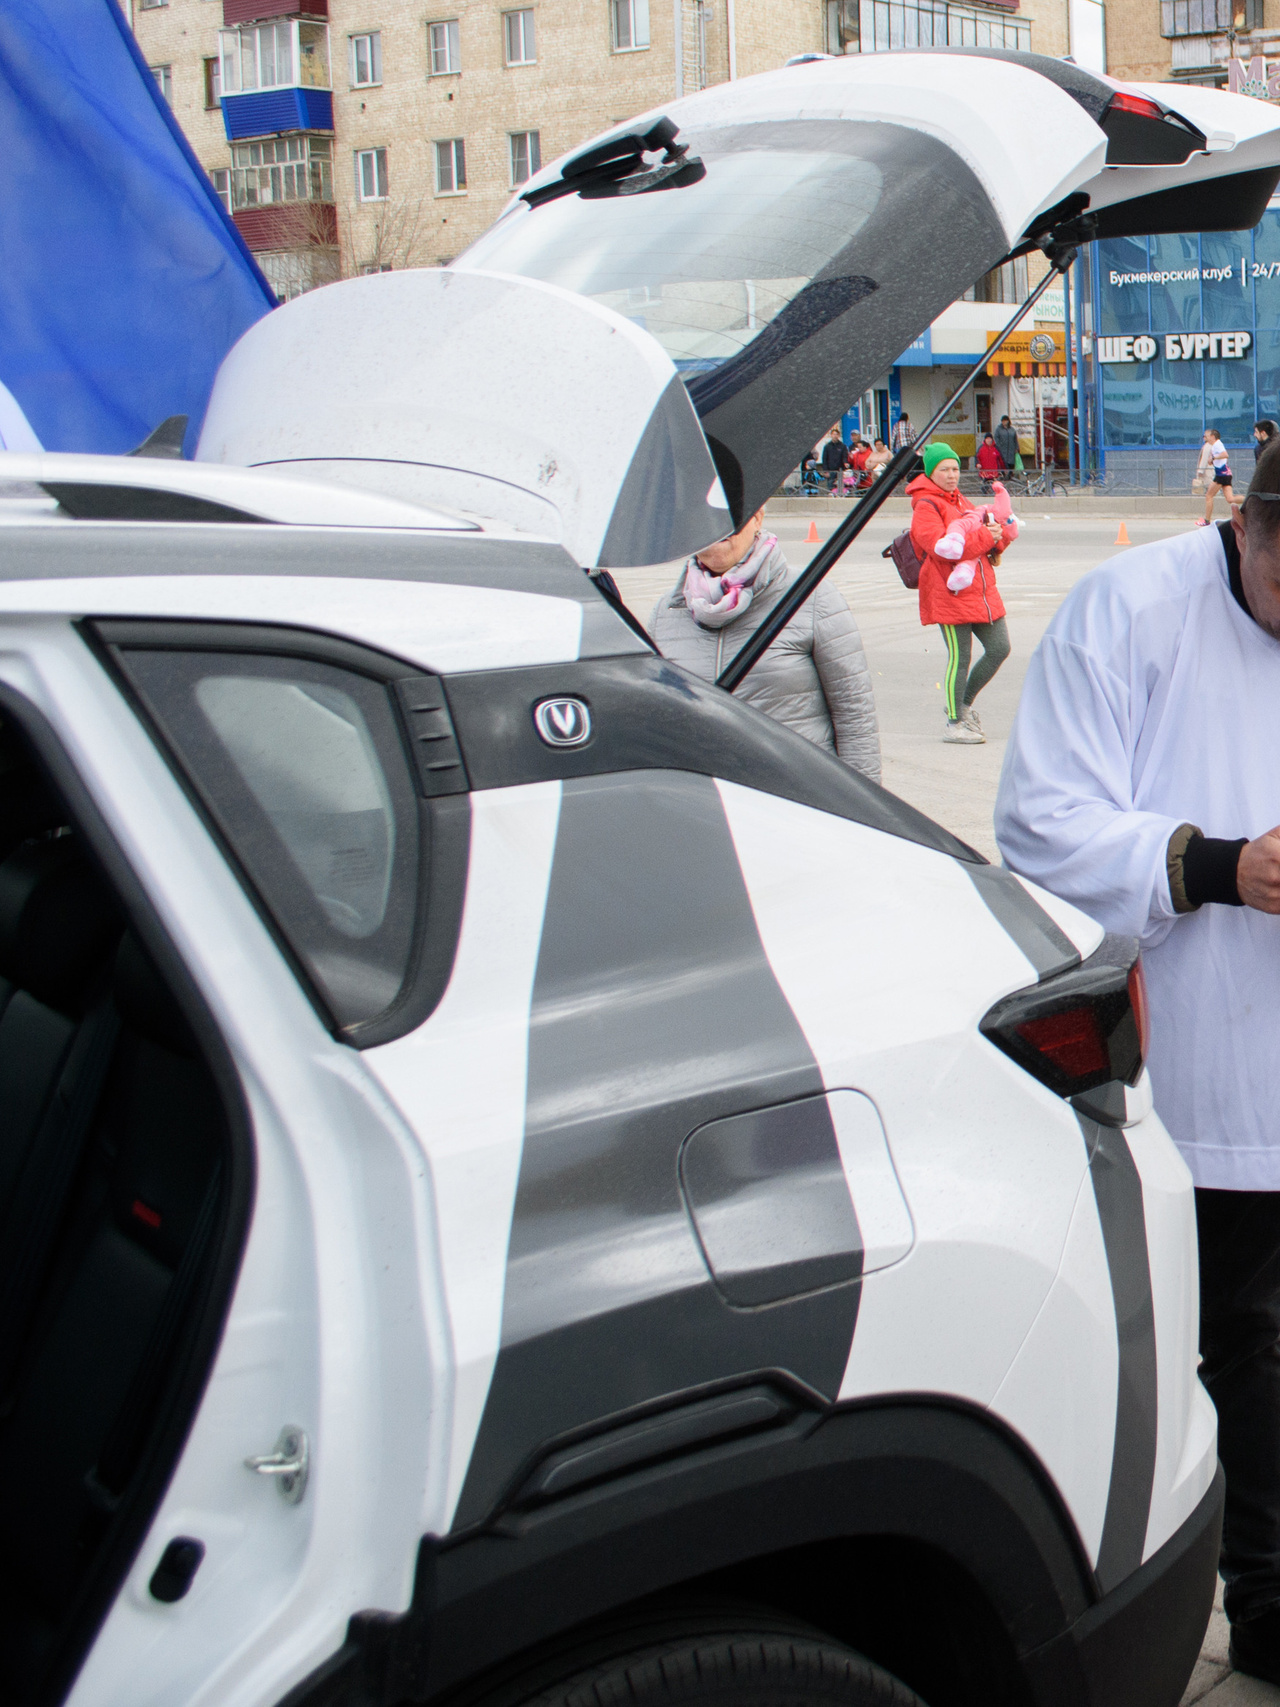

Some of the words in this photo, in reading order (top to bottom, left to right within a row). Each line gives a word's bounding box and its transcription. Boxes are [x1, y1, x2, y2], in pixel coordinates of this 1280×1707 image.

[1109, 268, 1200, 287] Букмекерский
[1202, 265, 1233, 283] клуб
[1098, 335, 1157, 363] ШЕФ
[1165, 331, 1252, 361] БУРГЕР
